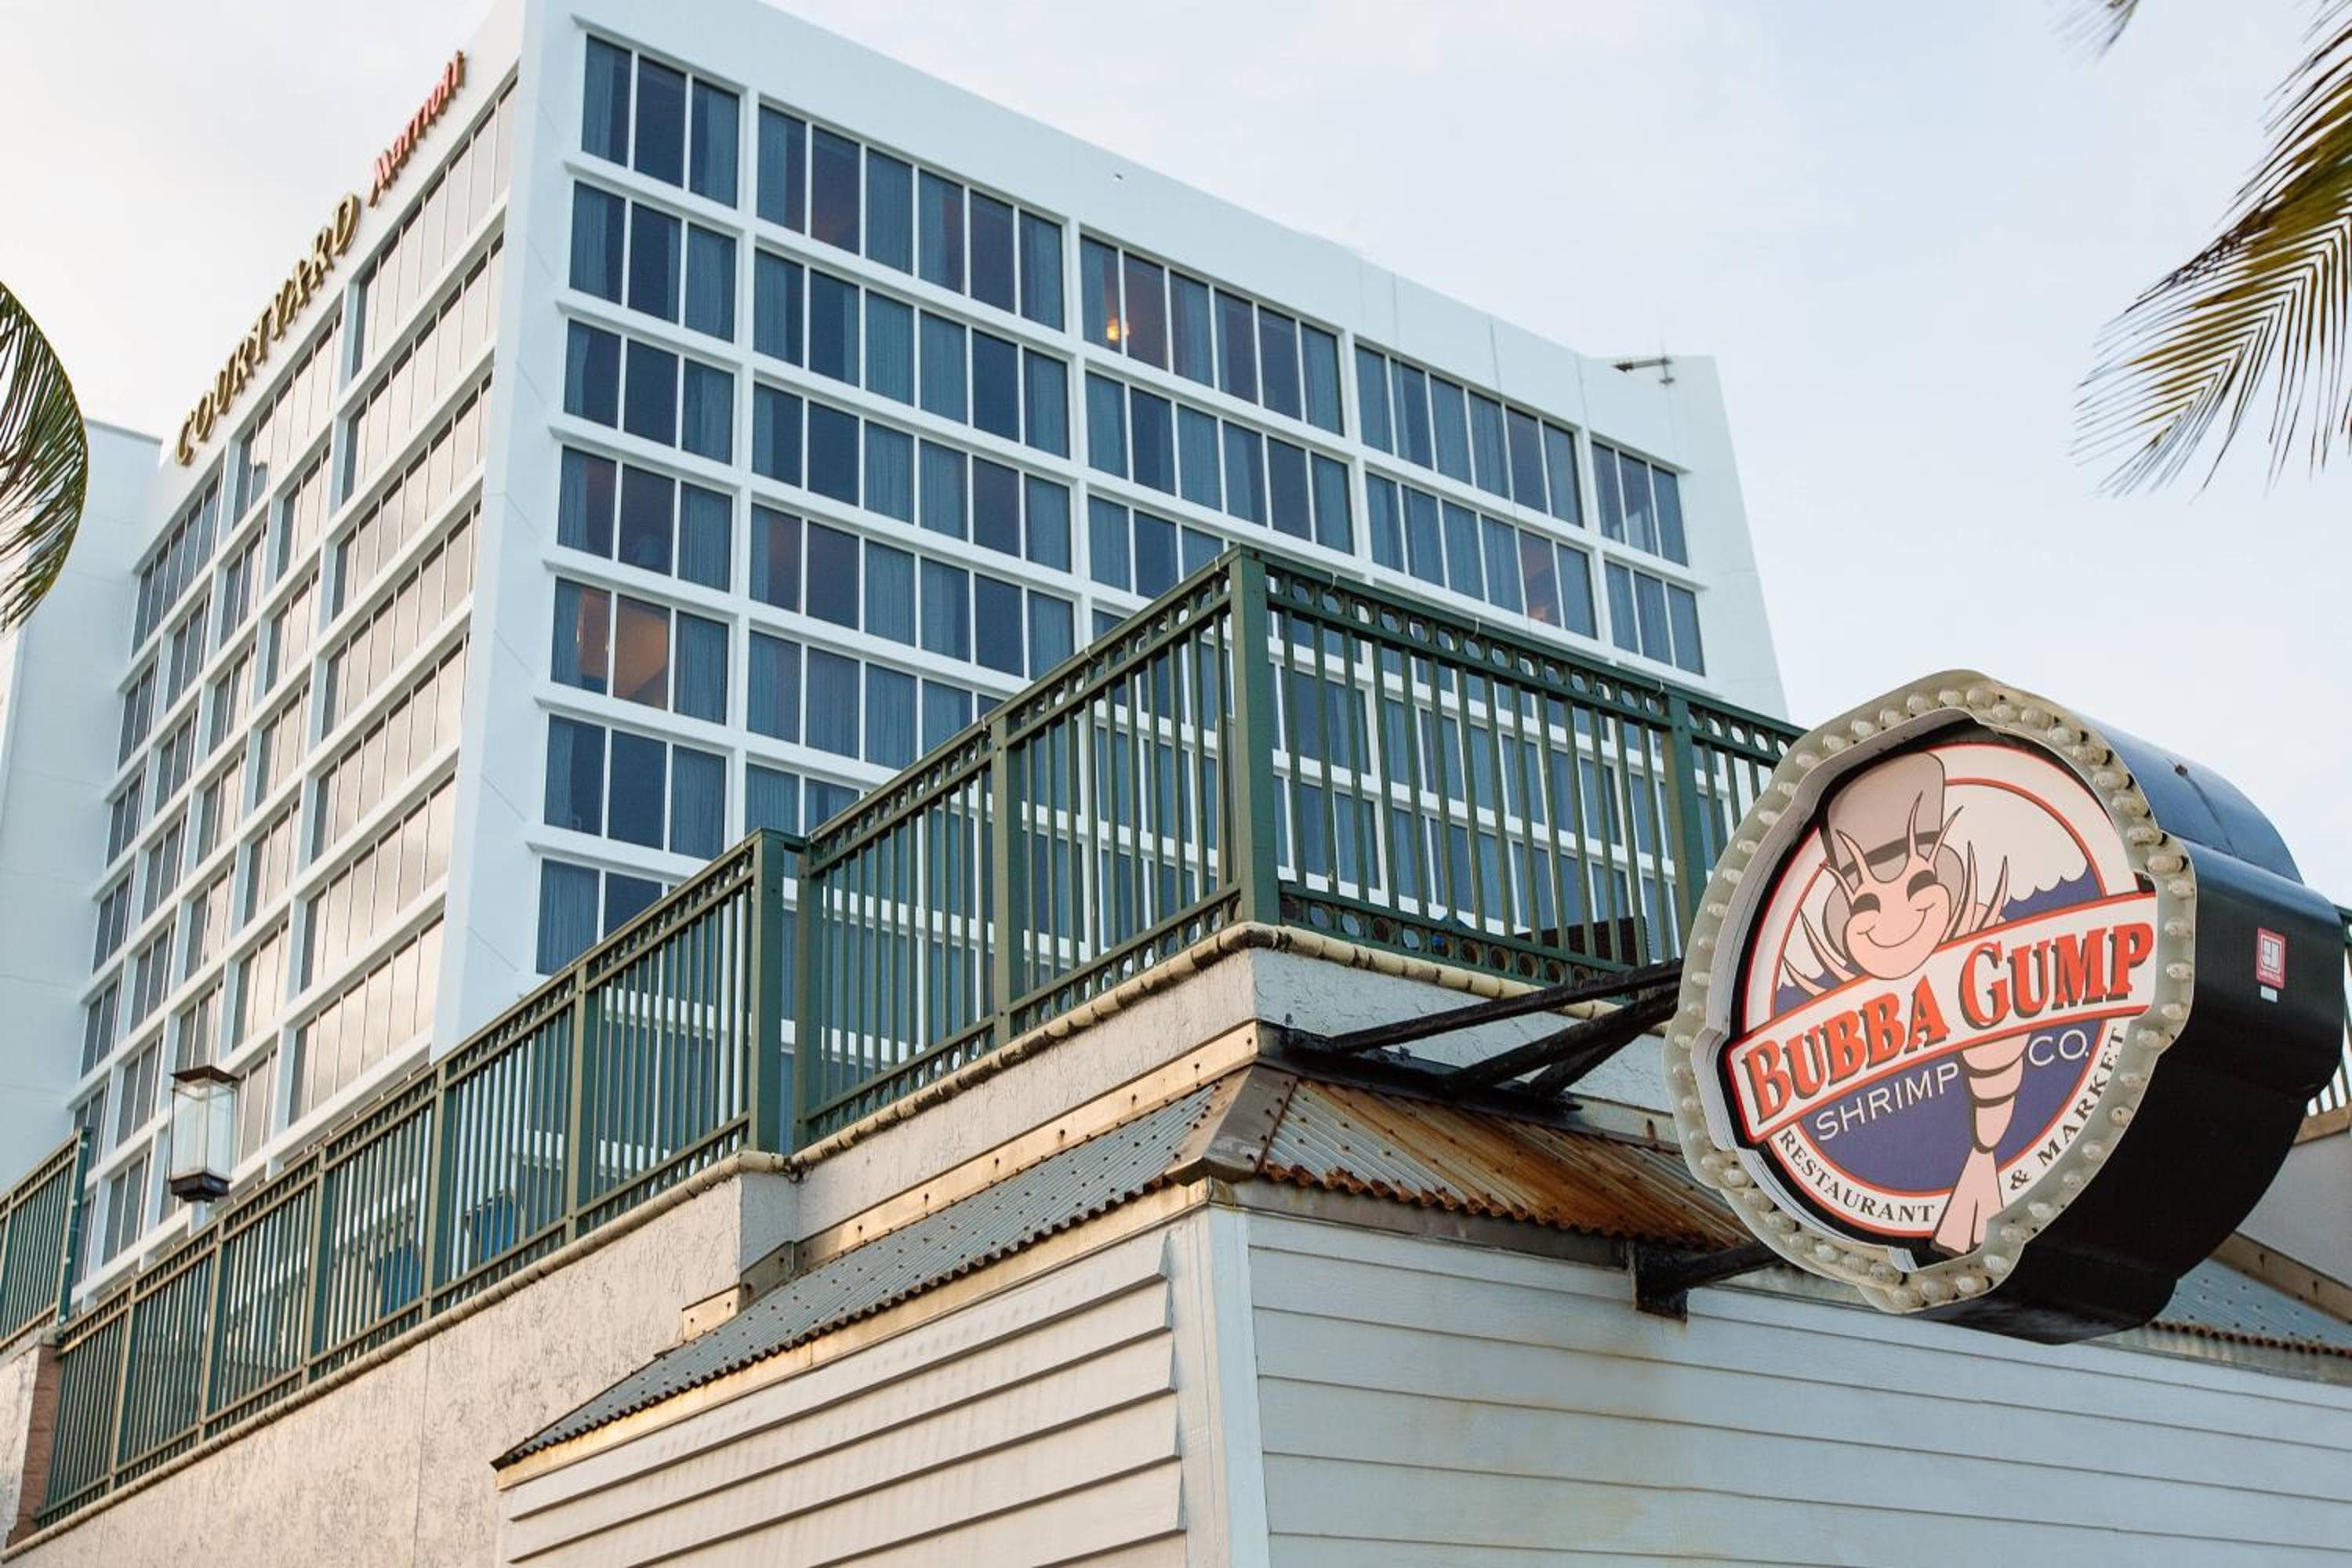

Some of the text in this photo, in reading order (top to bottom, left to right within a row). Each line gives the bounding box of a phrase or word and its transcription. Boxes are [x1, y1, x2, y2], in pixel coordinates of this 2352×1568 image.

[176, 49, 466, 466] COURTYARD Marriott
[1742, 923, 2154, 1125] BUBBA GUMP
[1816, 1029, 2090, 1142] SHRIMP CO.
[1780, 1028, 2123, 1223] RESTAURANT & MARKET
